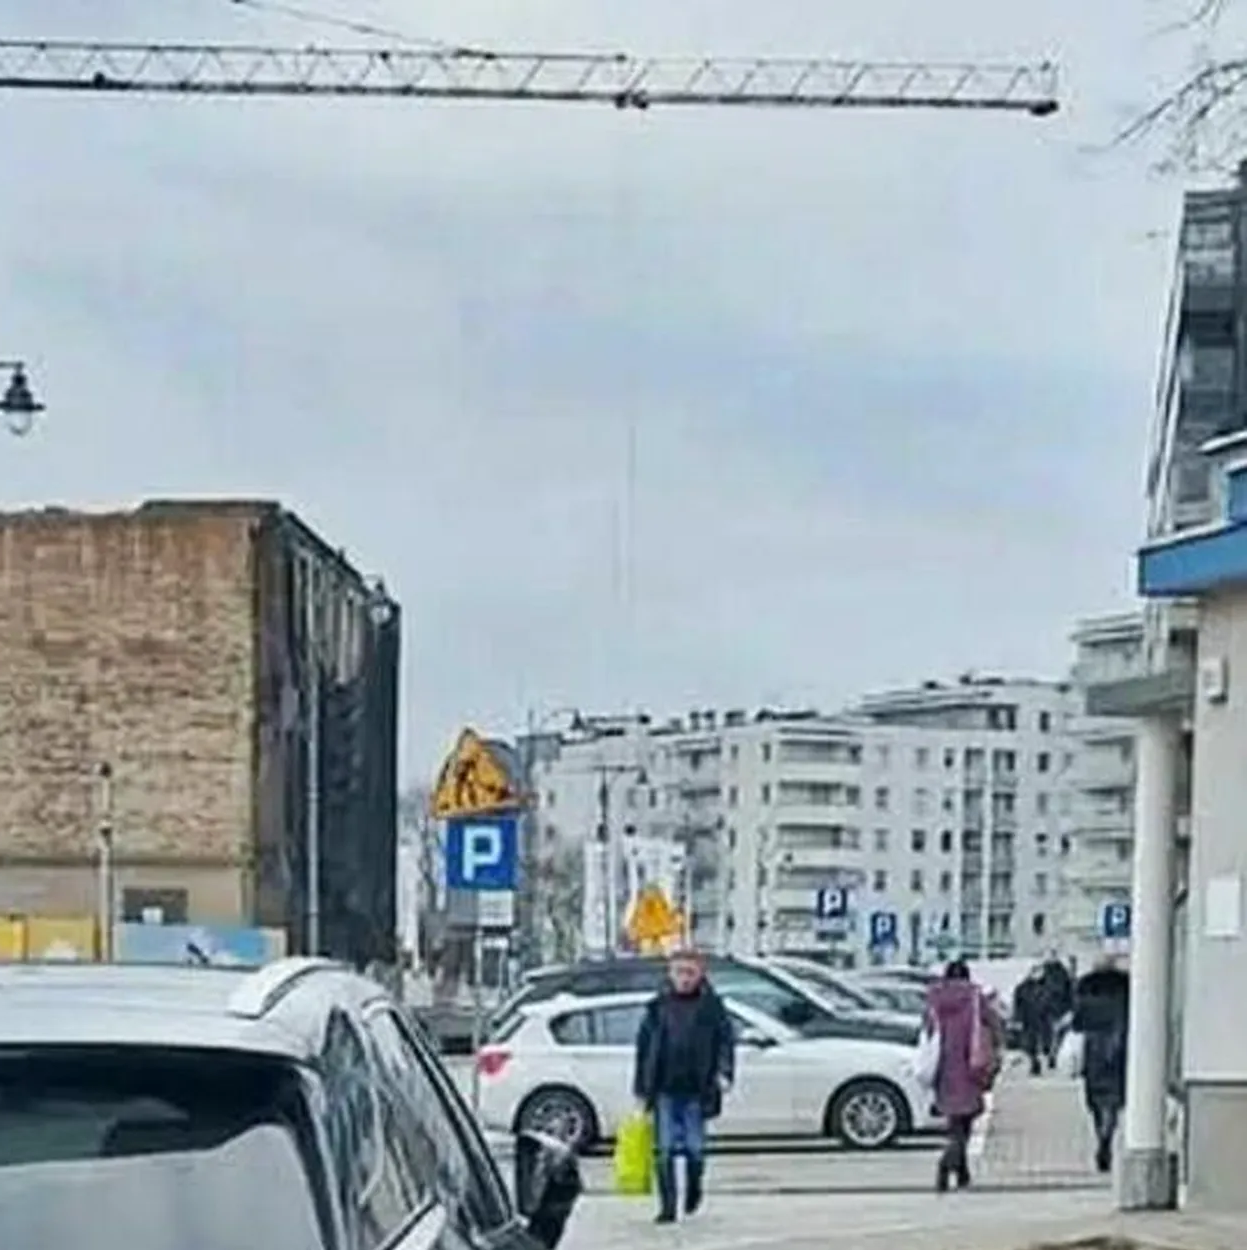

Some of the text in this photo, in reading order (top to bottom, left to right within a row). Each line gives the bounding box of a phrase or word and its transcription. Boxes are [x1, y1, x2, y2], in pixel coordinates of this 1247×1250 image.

[462, 825, 502, 881] P
[822, 887, 843, 915] P
[876, 916, 892, 939] P
[1112, 906, 1127, 928] P
